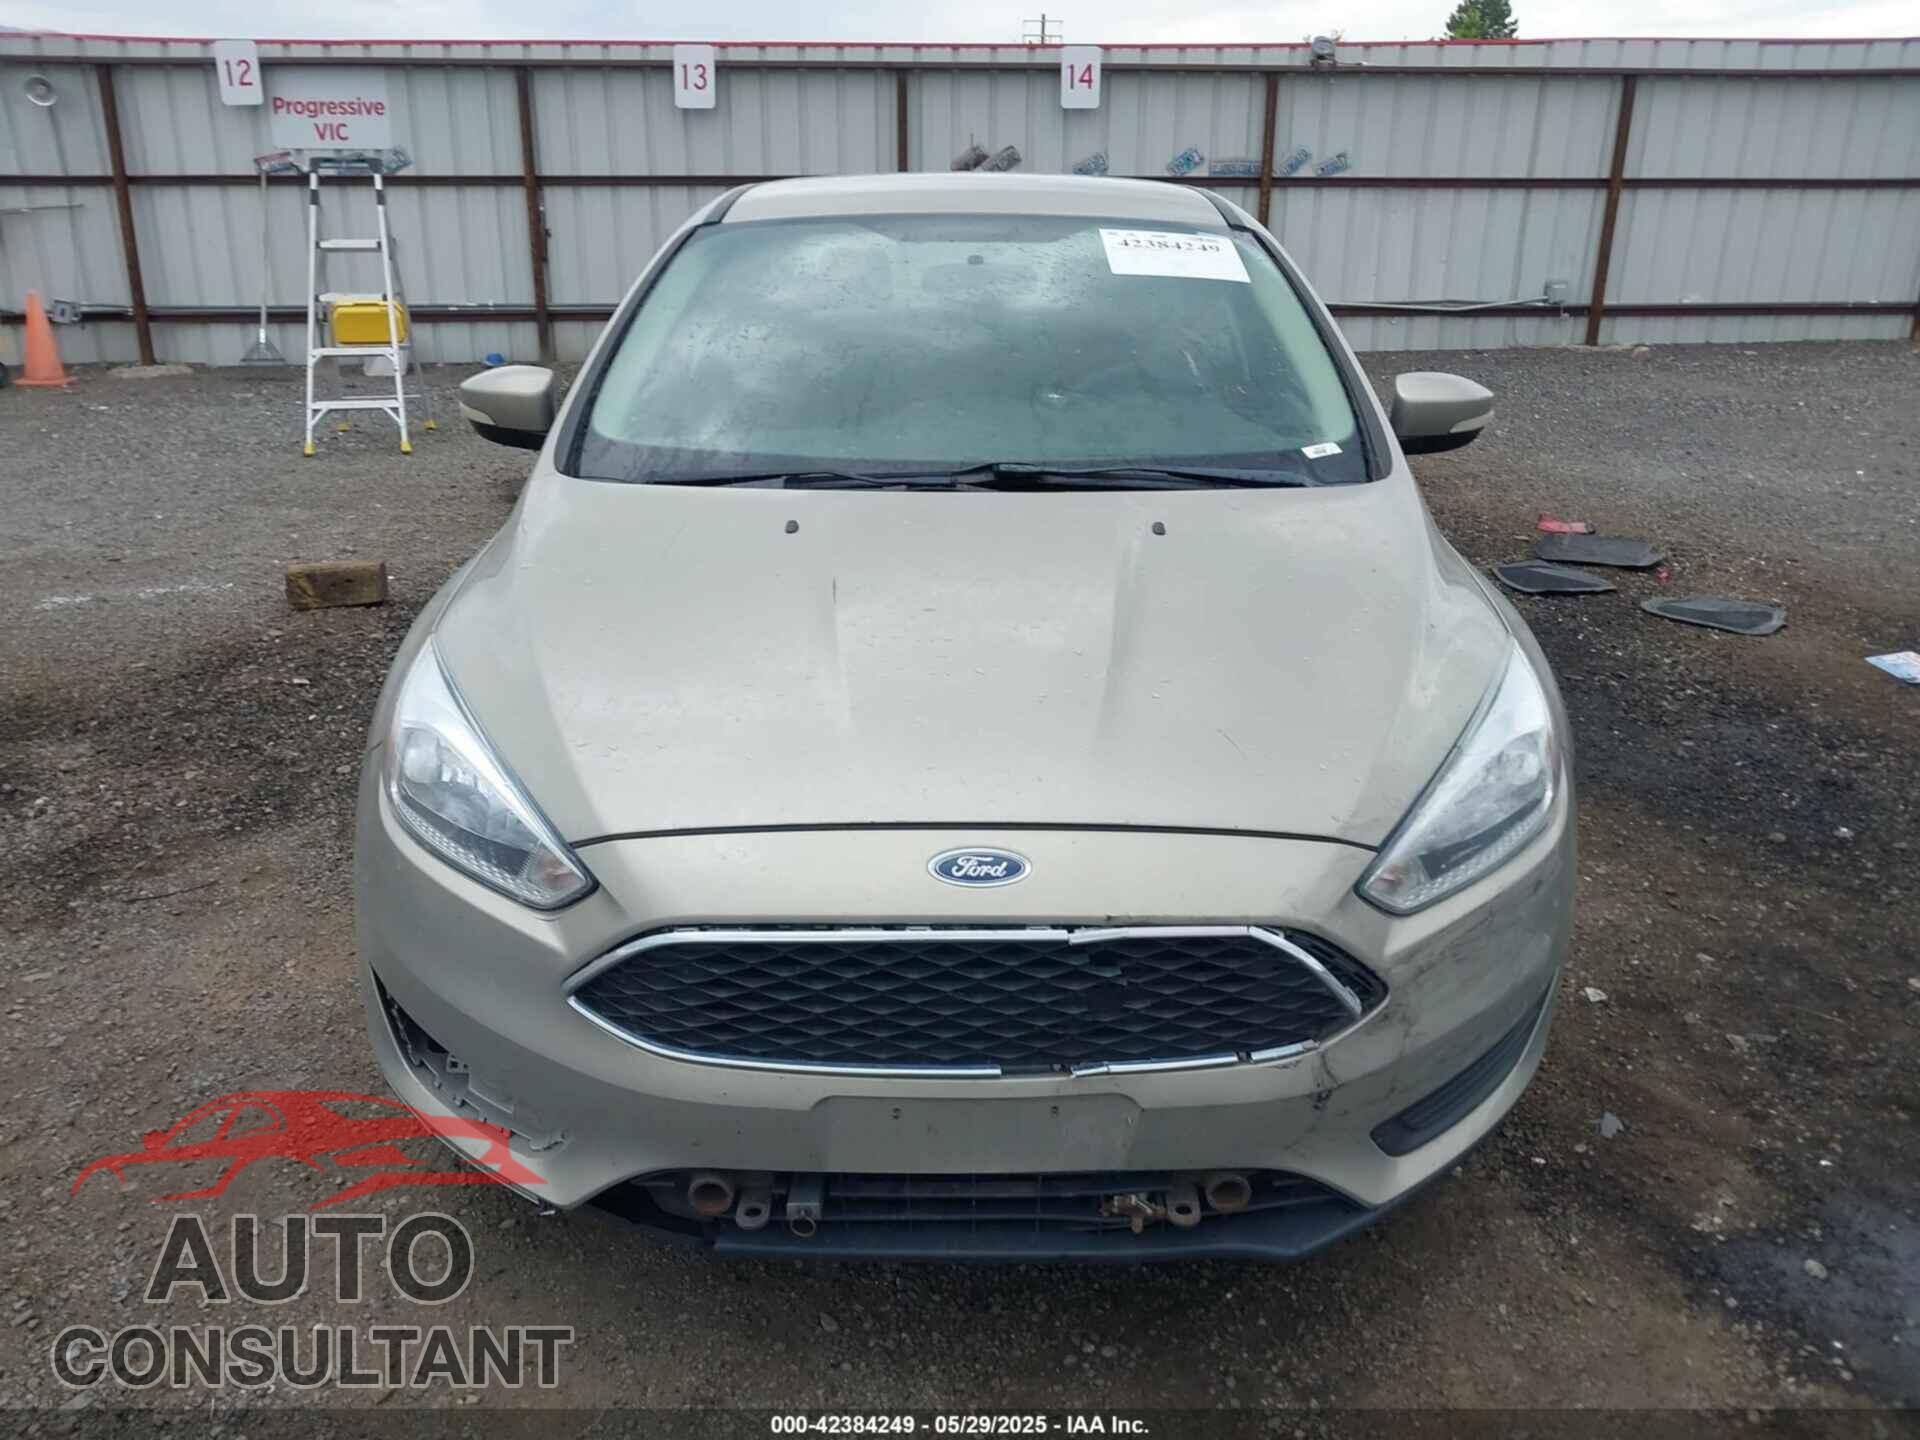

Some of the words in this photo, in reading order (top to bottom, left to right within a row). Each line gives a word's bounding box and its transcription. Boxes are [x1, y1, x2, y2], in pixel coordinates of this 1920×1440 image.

[224, 60, 253, 87] 12
[682, 64, 707, 90] 13
[1067, 64, 1093, 90] 14
[272, 97, 385, 118] Progressive
[314, 123, 349, 141] VIC
[951, 855, 1008, 877] Ford
